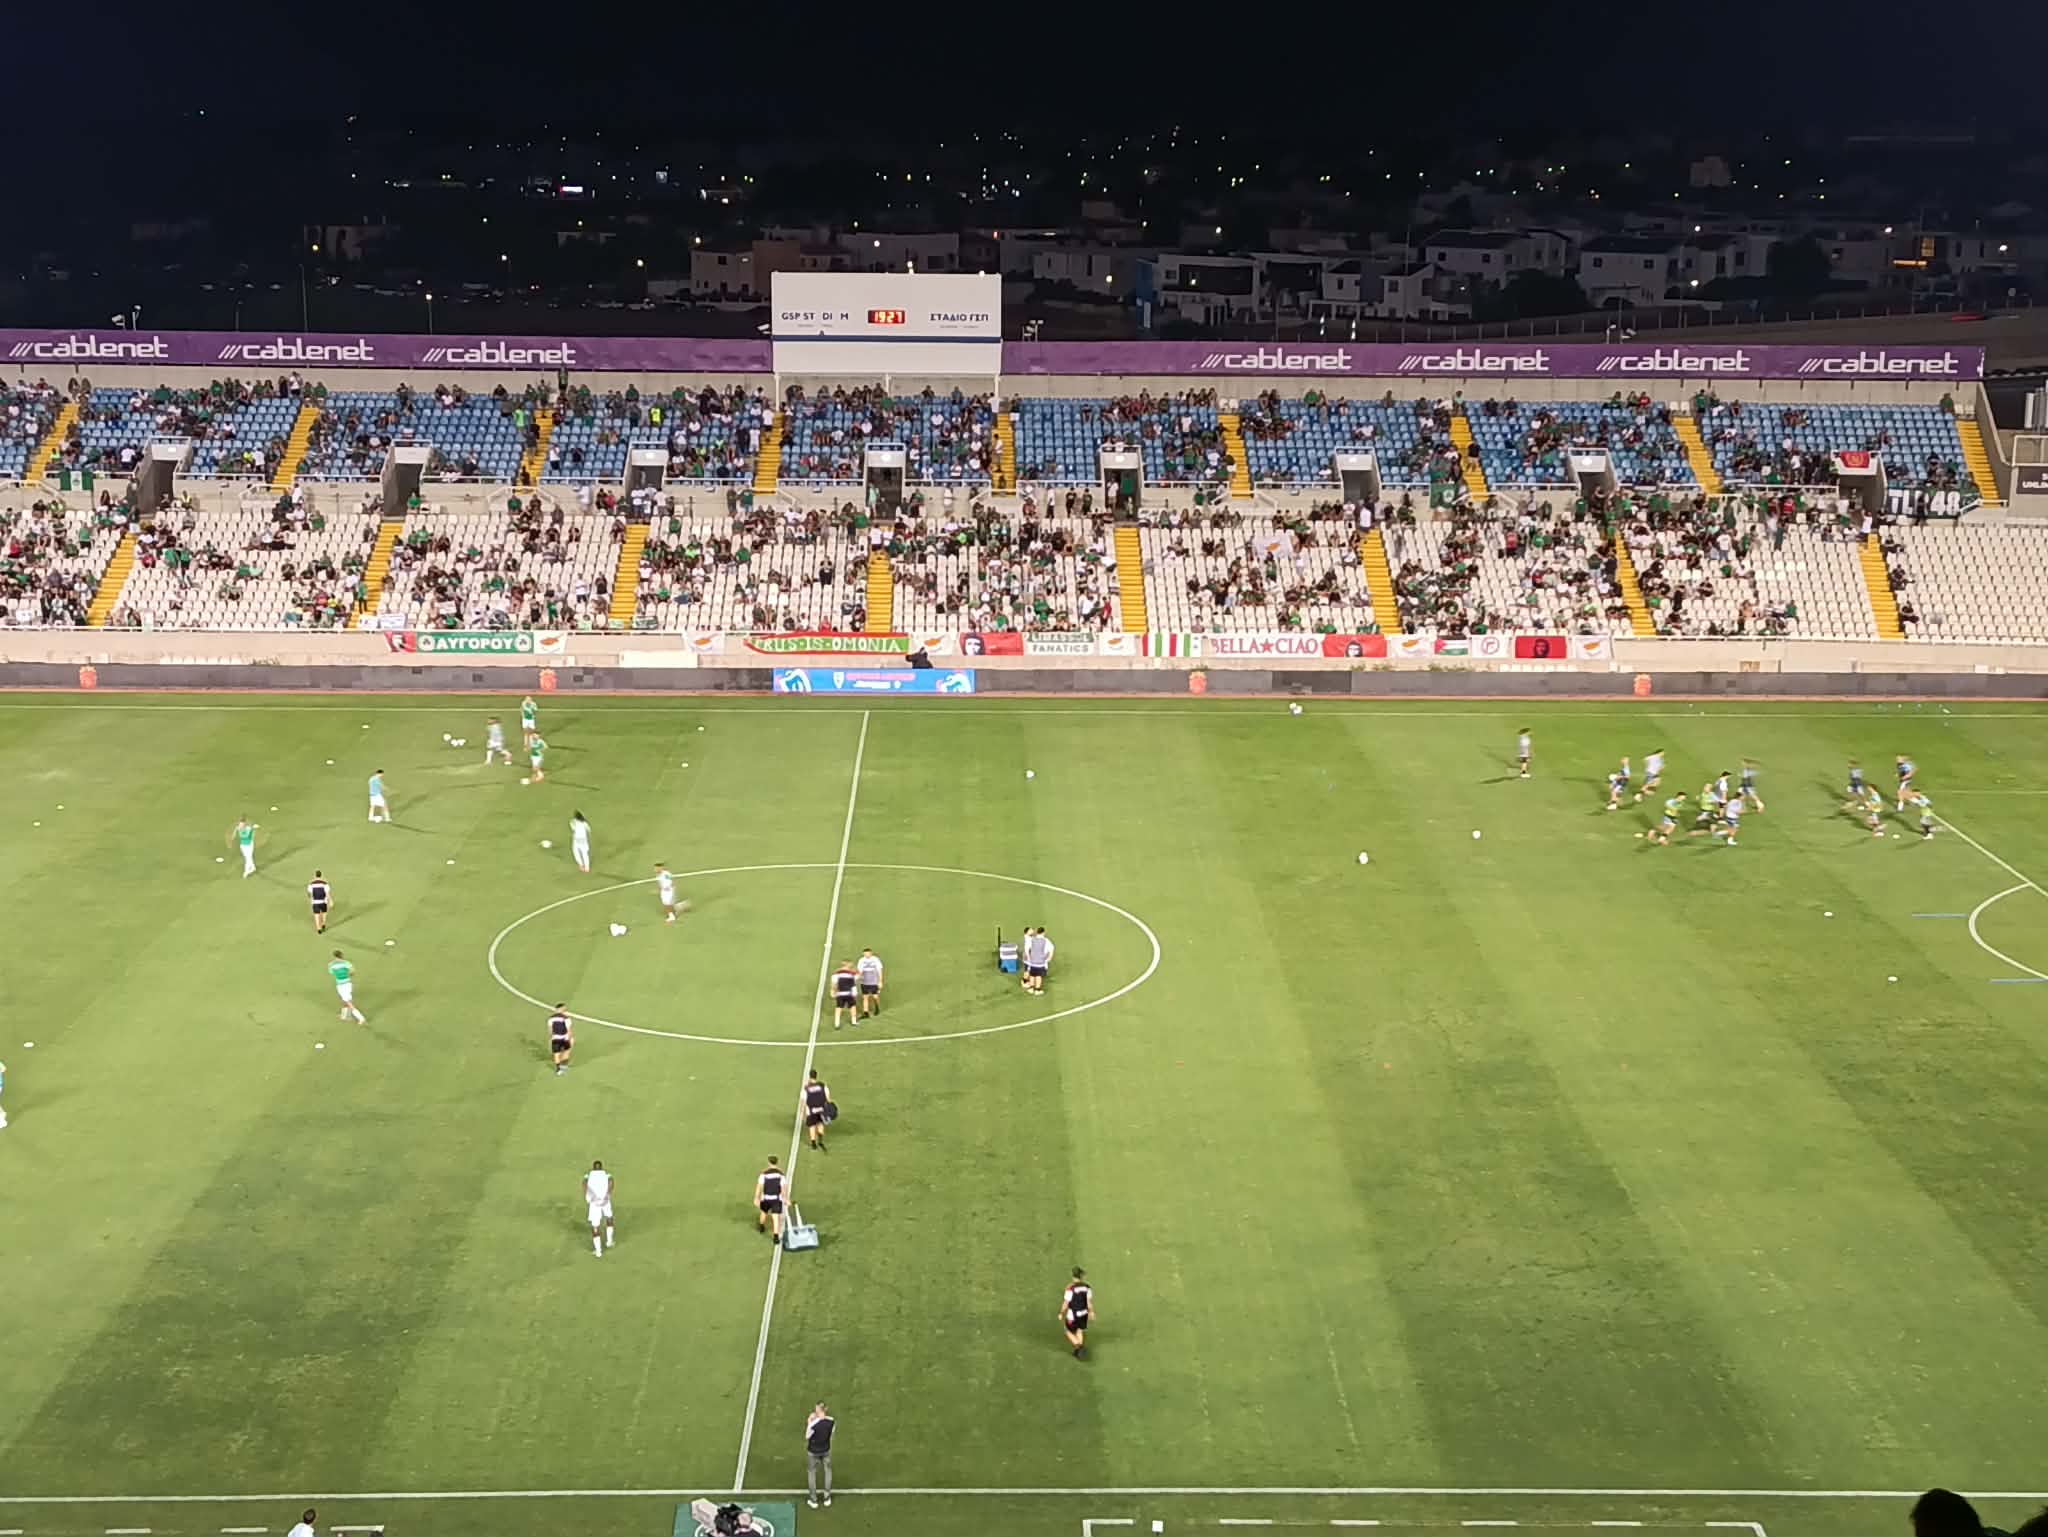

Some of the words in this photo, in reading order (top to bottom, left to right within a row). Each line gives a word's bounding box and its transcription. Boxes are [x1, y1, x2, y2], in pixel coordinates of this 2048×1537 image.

[781, 312, 801, 321] GSP
[34, 335, 169, 358] cablenet
[242, 337, 375, 361] cablenet
[446, 341, 577, 364] cablenet
[1223, 347, 1352, 370] cablenet
[1422, 348, 1550, 371] cablenet
[1620, 348, 1751, 372] cablenet
[1823, 351, 1959, 374] cablenet
[436, 637, 514, 650] ΑΥΓΟΡΟΥ
[832, 638, 901, 652] OMONIA
[1032, 644, 1089, 653] FANATICS
[1211, 638, 1260, 654] BELLA
[1275, 638, 1319, 654] CIAO
